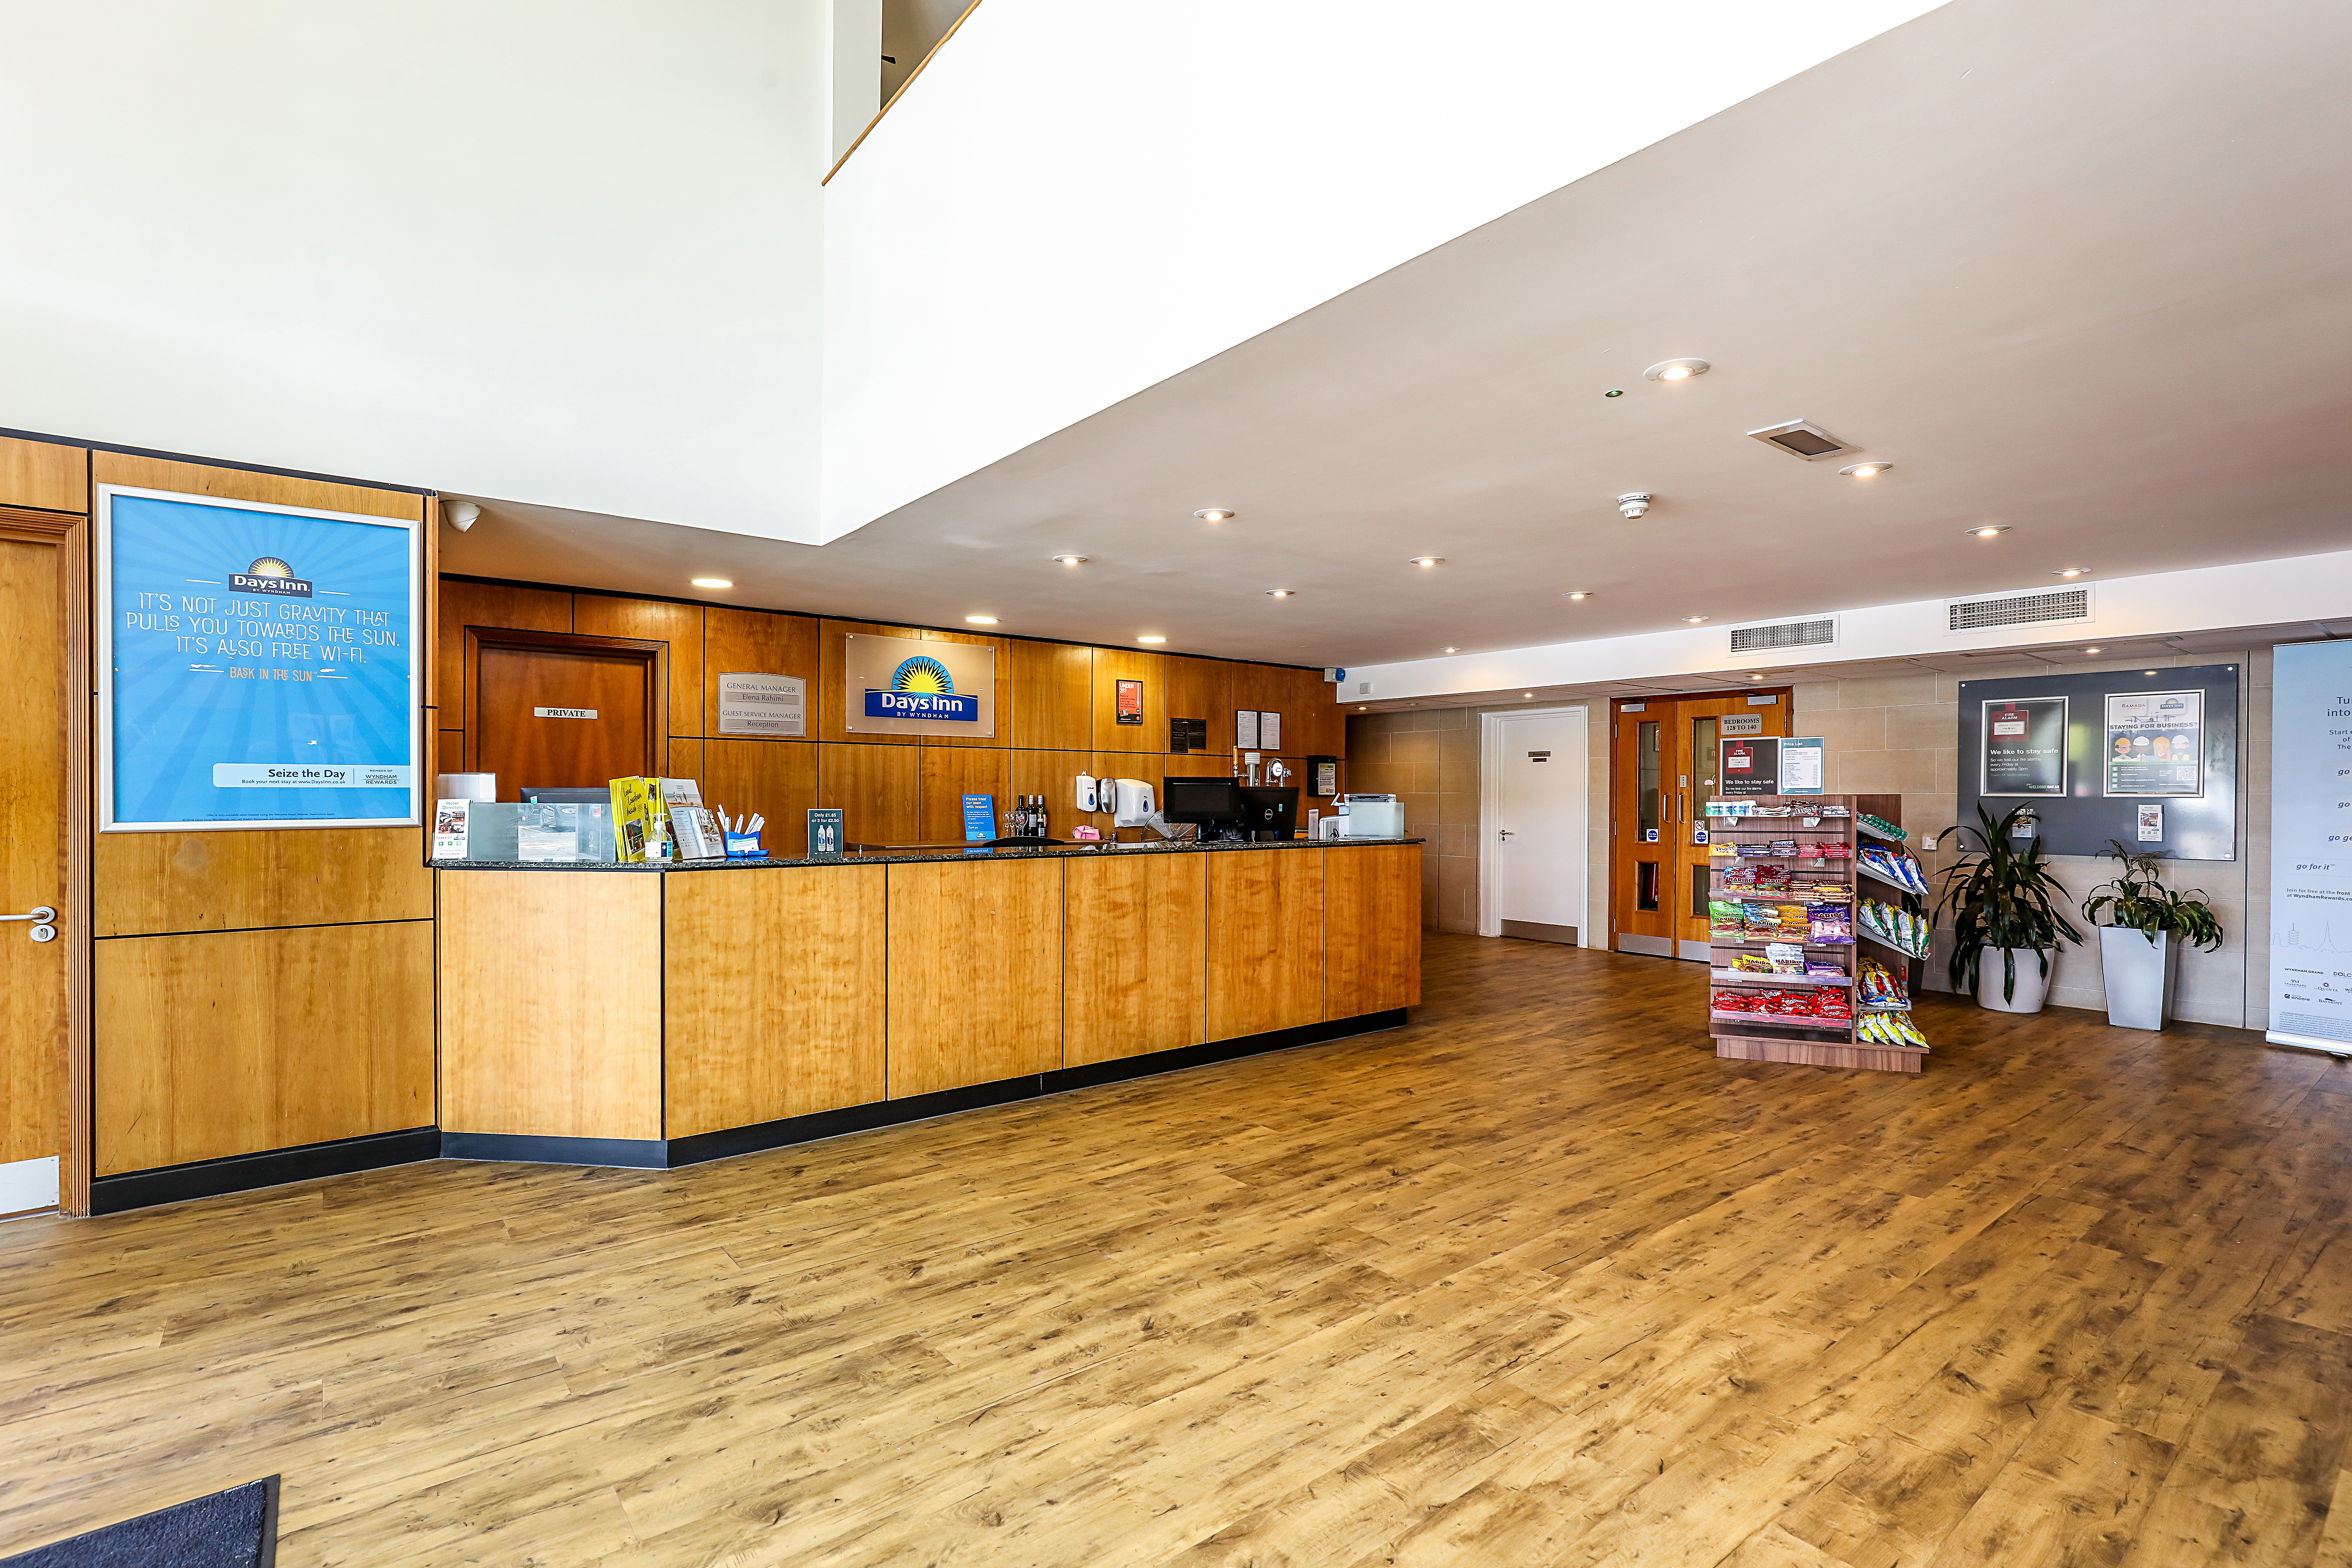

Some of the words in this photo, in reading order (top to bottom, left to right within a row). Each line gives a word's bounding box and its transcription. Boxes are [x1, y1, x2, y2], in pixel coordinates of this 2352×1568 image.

[234, 575, 278, 589] Days
[139, 592, 172, 611] IT'S
[182, 596, 217, 613] NOT
[225, 600, 271, 618] JUST
[279, 603, 346, 623] GRAVITY
[353, 609, 390, 627] THAT
[126, 612, 180, 631] PULLS
[188, 616, 227, 634] YOU
[237, 620, 319, 641] TOWARDS
[328, 626, 354, 643] THE
[362, 629, 400, 647] SUN.
[177, 636, 208, 654] IT'S
[217, 639, 262, 657] ALSO
[272, 642, 312, 659] FREE
[320, 645, 366, 663] WI-FI.
[230, 667, 254, 679] BASK
[260, 669, 268, 679] IN
[273, 669, 288, 680] THE
[882, 693, 929, 711] Days
[933, 696, 963, 711] Inn
[268, 769, 298, 777] Seize
[324, 770, 345, 780] Day
[623, 784, 632, 797] Local
